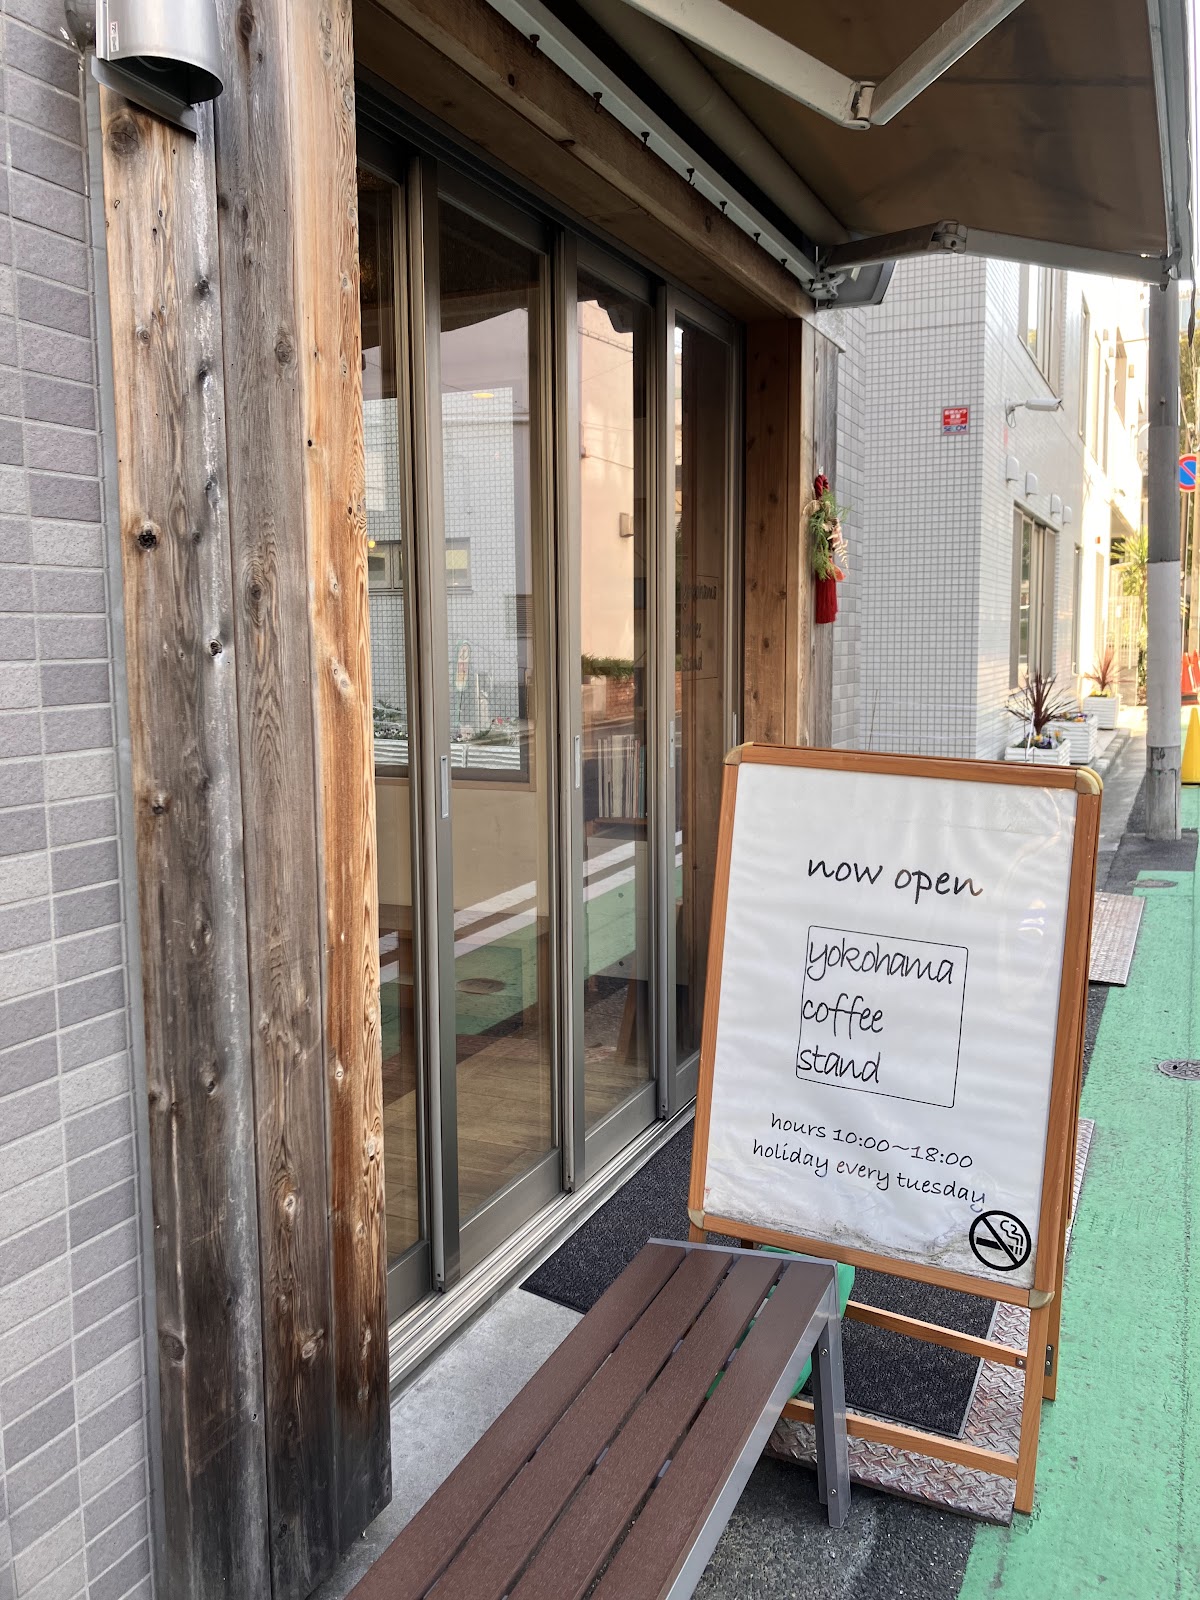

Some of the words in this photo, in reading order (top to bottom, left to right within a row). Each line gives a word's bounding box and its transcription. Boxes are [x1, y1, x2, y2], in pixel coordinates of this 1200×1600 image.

[807, 859, 884, 885] now
[894, 869, 984, 905] open
[806, 937, 954, 985] yokohama
[802, 992, 884, 1040] coffee
[796, 1044, 881, 1084] stand
[771, 1112, 827, 1139] hours
[752, 1138, 829, 1179] holiday
[836, 1160, 890, 1191] every
[896, 1172, 987, 1214] tuesday
